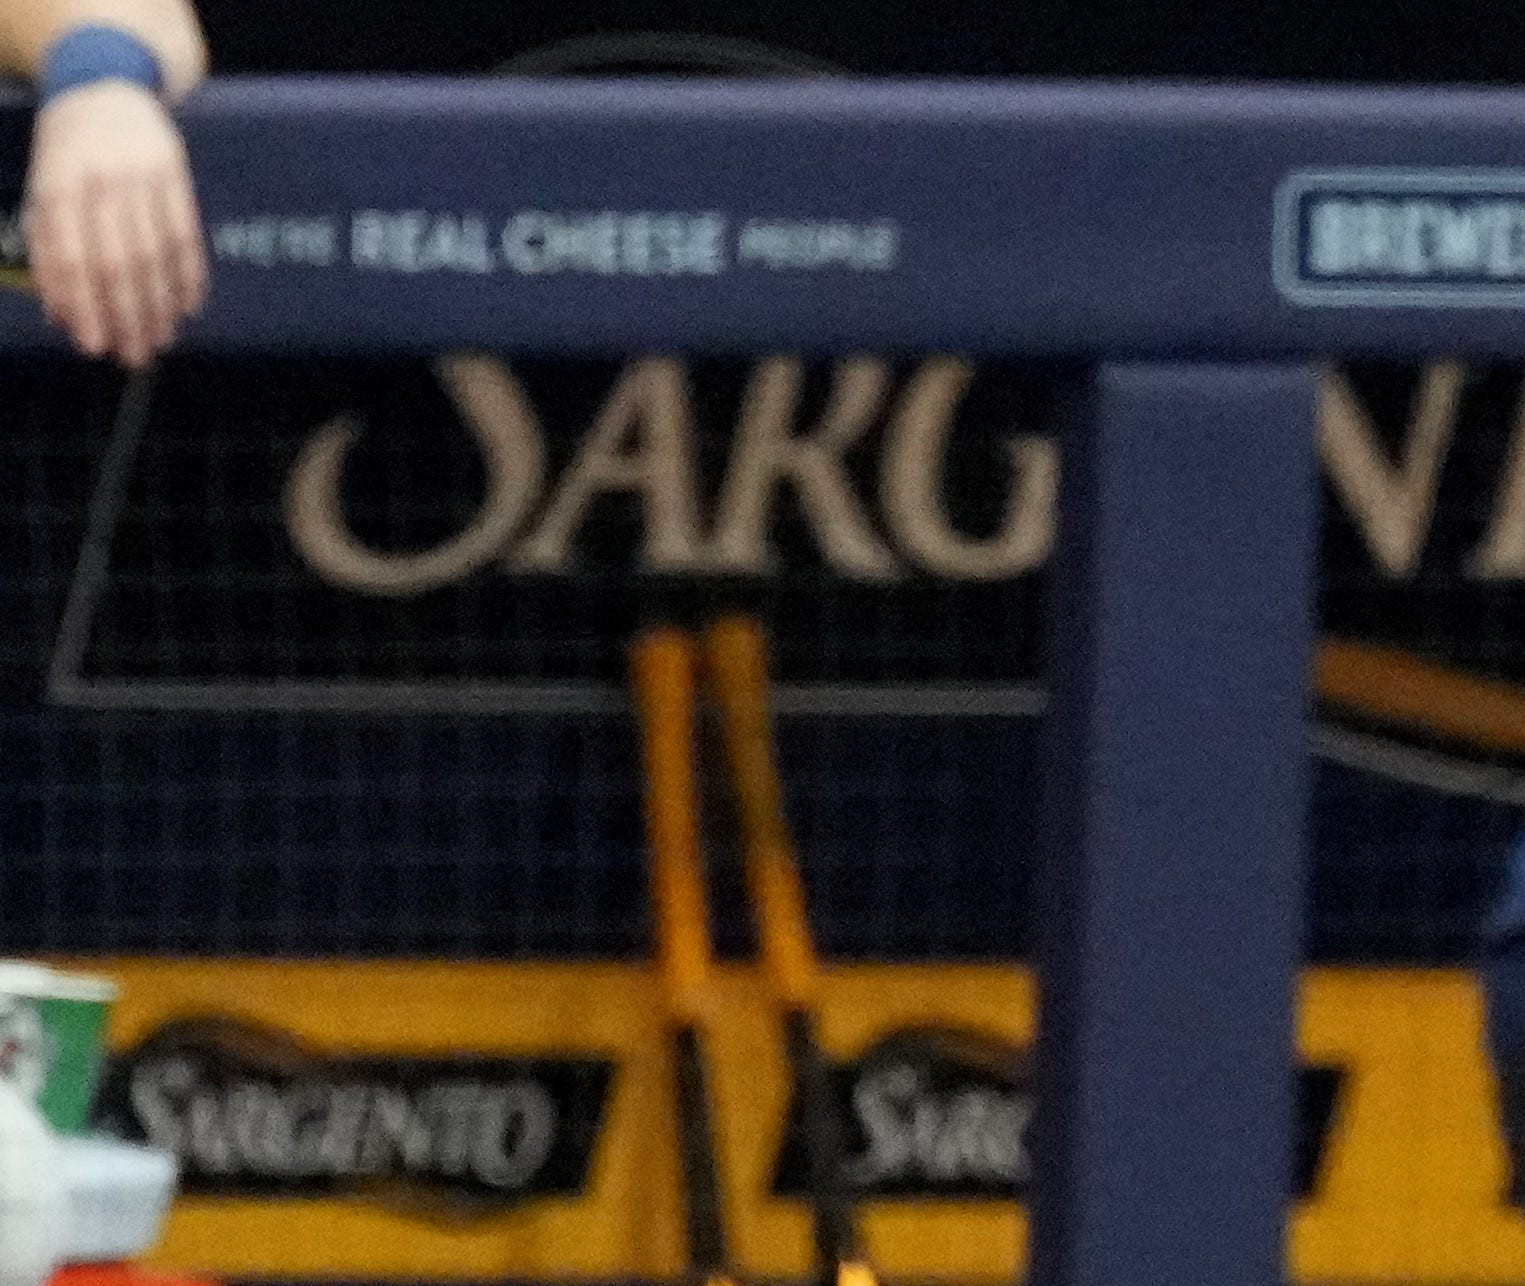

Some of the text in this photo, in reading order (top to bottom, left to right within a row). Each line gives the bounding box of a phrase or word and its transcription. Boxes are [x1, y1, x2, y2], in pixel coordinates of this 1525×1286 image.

[350, 209, 491, 274] REAL
[502, 209, 726, 276] CHEESE
[737, 216, 897, 272] PEOPLE
